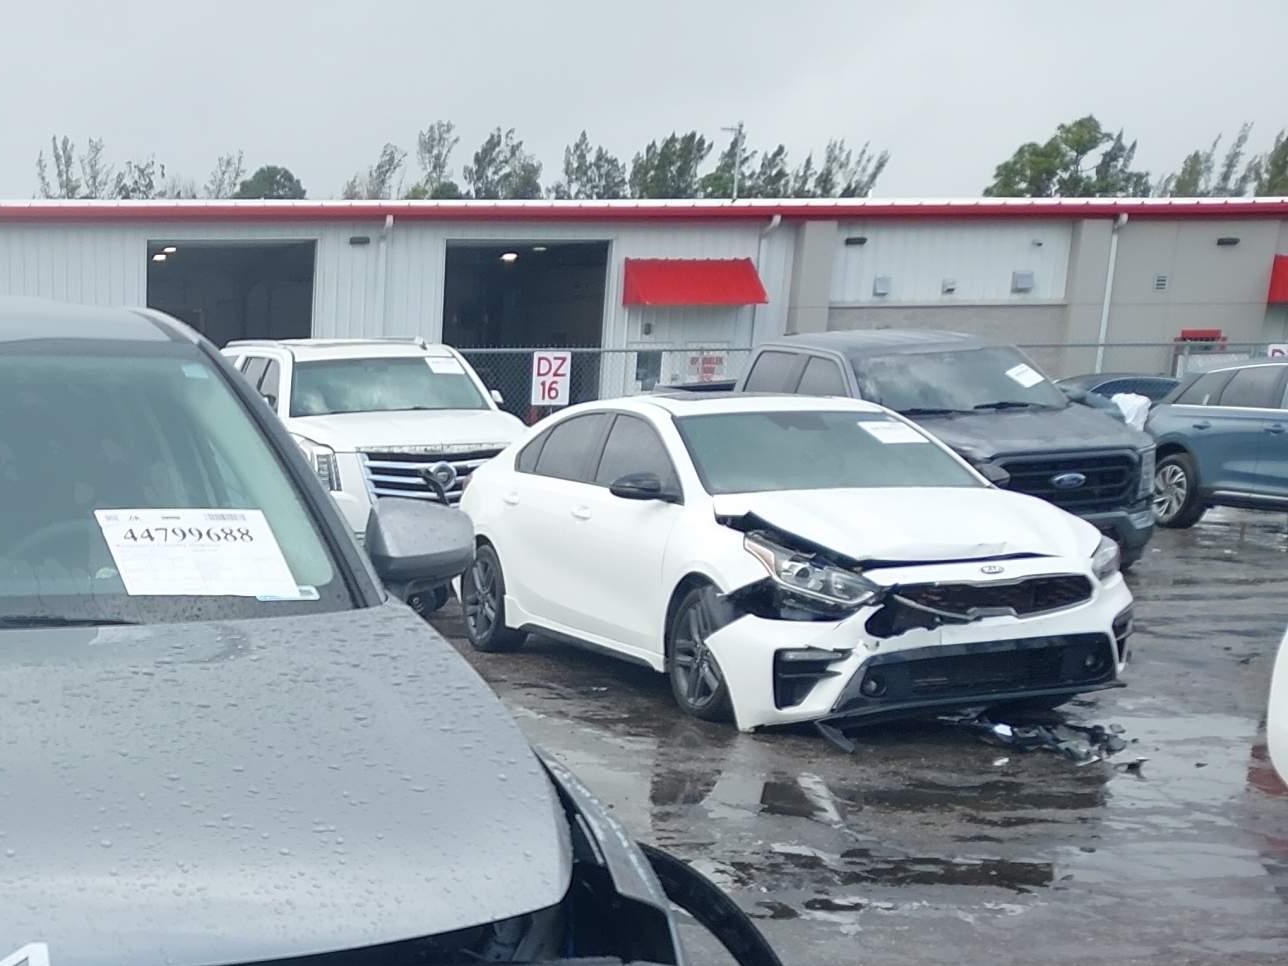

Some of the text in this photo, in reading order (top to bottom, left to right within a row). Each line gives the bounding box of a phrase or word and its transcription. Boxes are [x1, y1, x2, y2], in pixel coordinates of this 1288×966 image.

[537, 356, 567, 377] DZ
[540, 381, 559, 400] 16
[123, 527, 253, 543] 44799688
